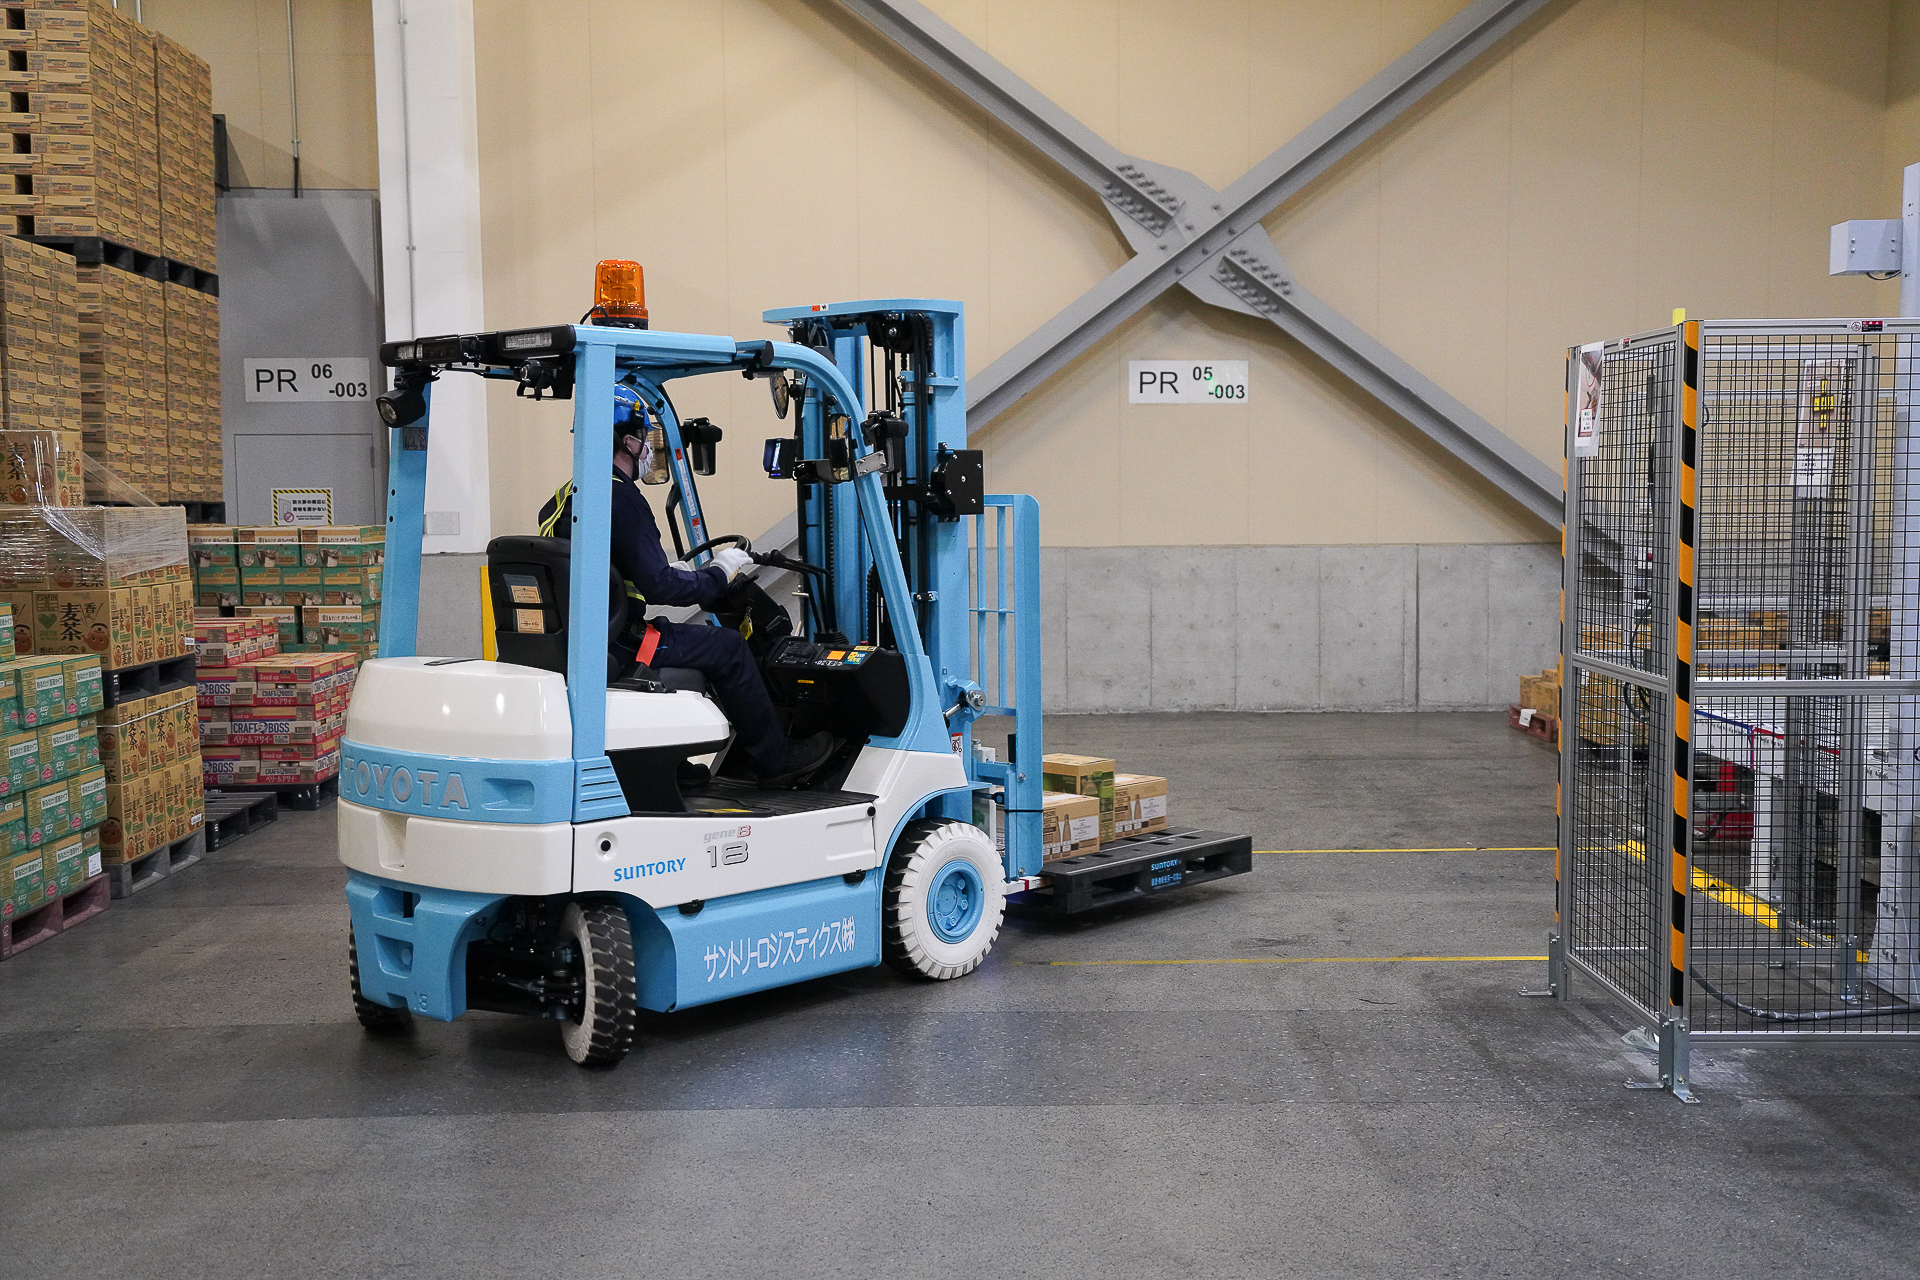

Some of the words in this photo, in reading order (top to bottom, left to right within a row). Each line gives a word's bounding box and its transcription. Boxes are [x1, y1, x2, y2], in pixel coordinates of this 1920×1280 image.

[256, 368, 299, 393] PR
[311, 363, 333, 379] 06
[328, 382, 368, 398] -003
[1139, 371, 1179, 394] PR
[1192, 366, 1214, 381] 05
[1208, 384, 1245, 399] -003
[59, 603, 82, 641] 麦茶
[209, 684, 231, 694] BOSS
[233, 723, 257, 734] CRAFT
[268, 722, 290, 733] BOSS
[212, 762, 234, 773] BOSS
[343, 756, 471, 811] TOYOTA
[706, 840, 749, 868] 18
[1150, 859, 1179, 871] SUNTORY
[613, 858, 686, 882] SUNTORY
